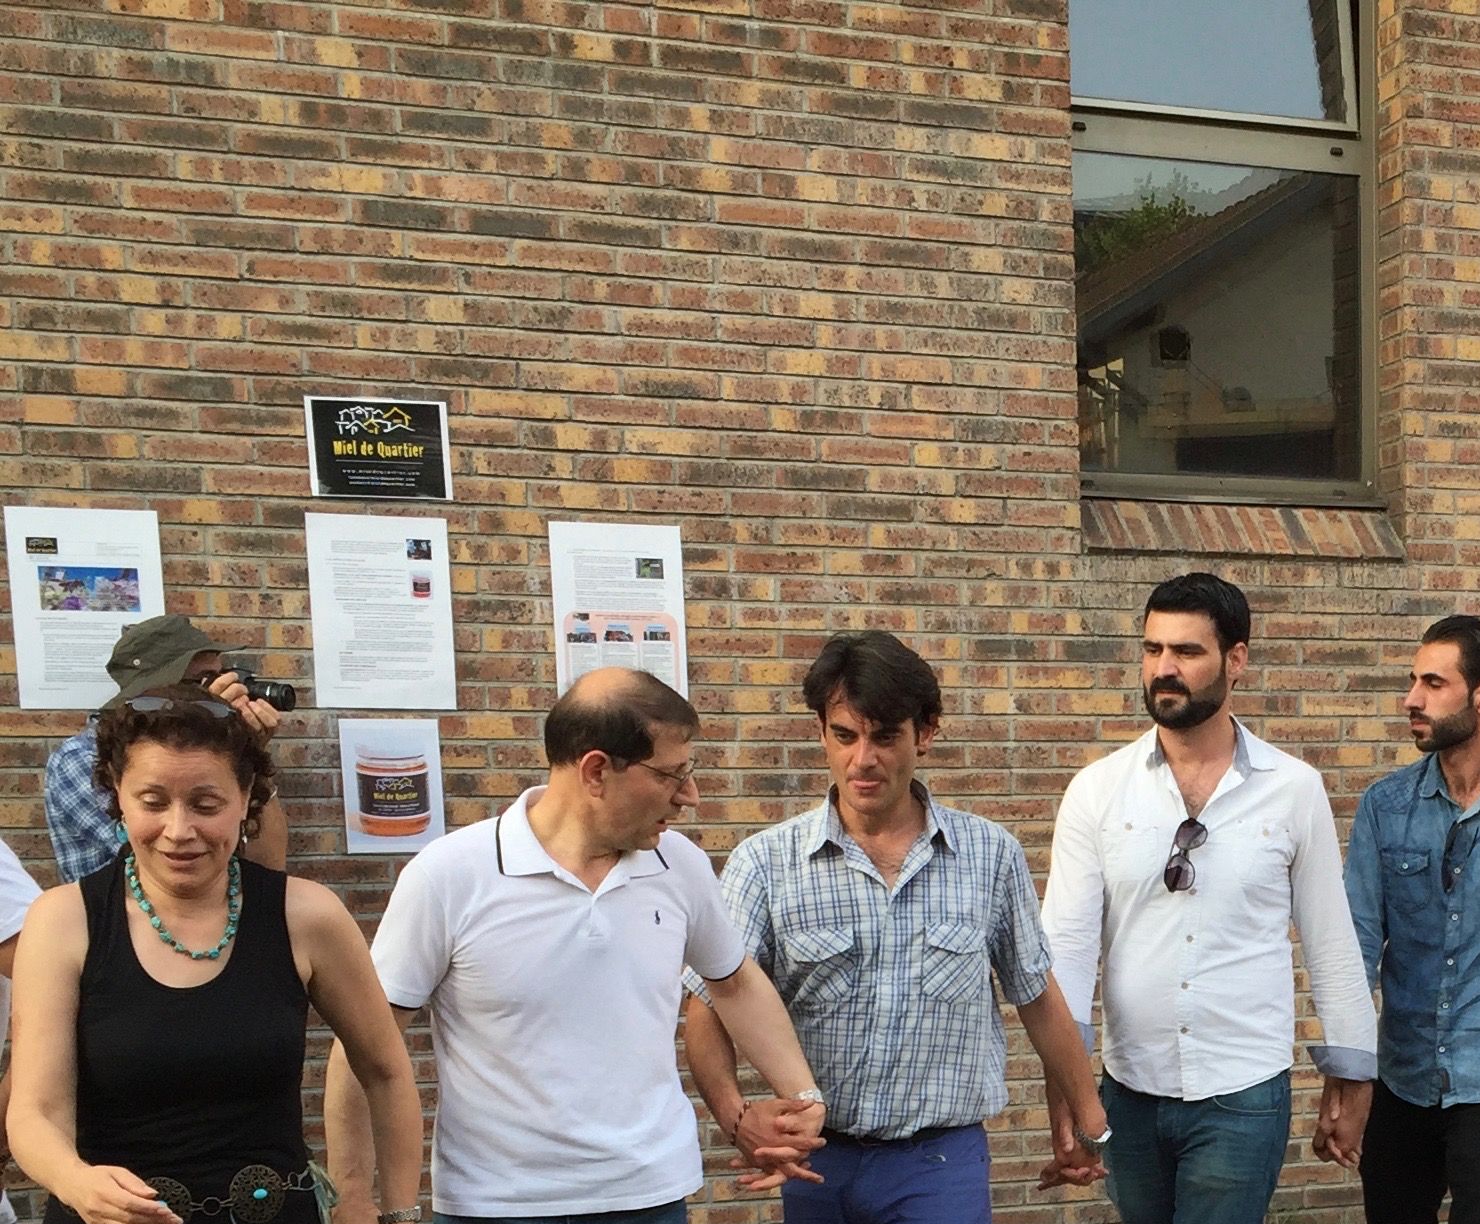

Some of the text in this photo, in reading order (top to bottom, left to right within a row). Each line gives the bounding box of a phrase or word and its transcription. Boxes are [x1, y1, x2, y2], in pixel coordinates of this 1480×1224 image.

[333, 439, 424, 458] Miel de Quartier
